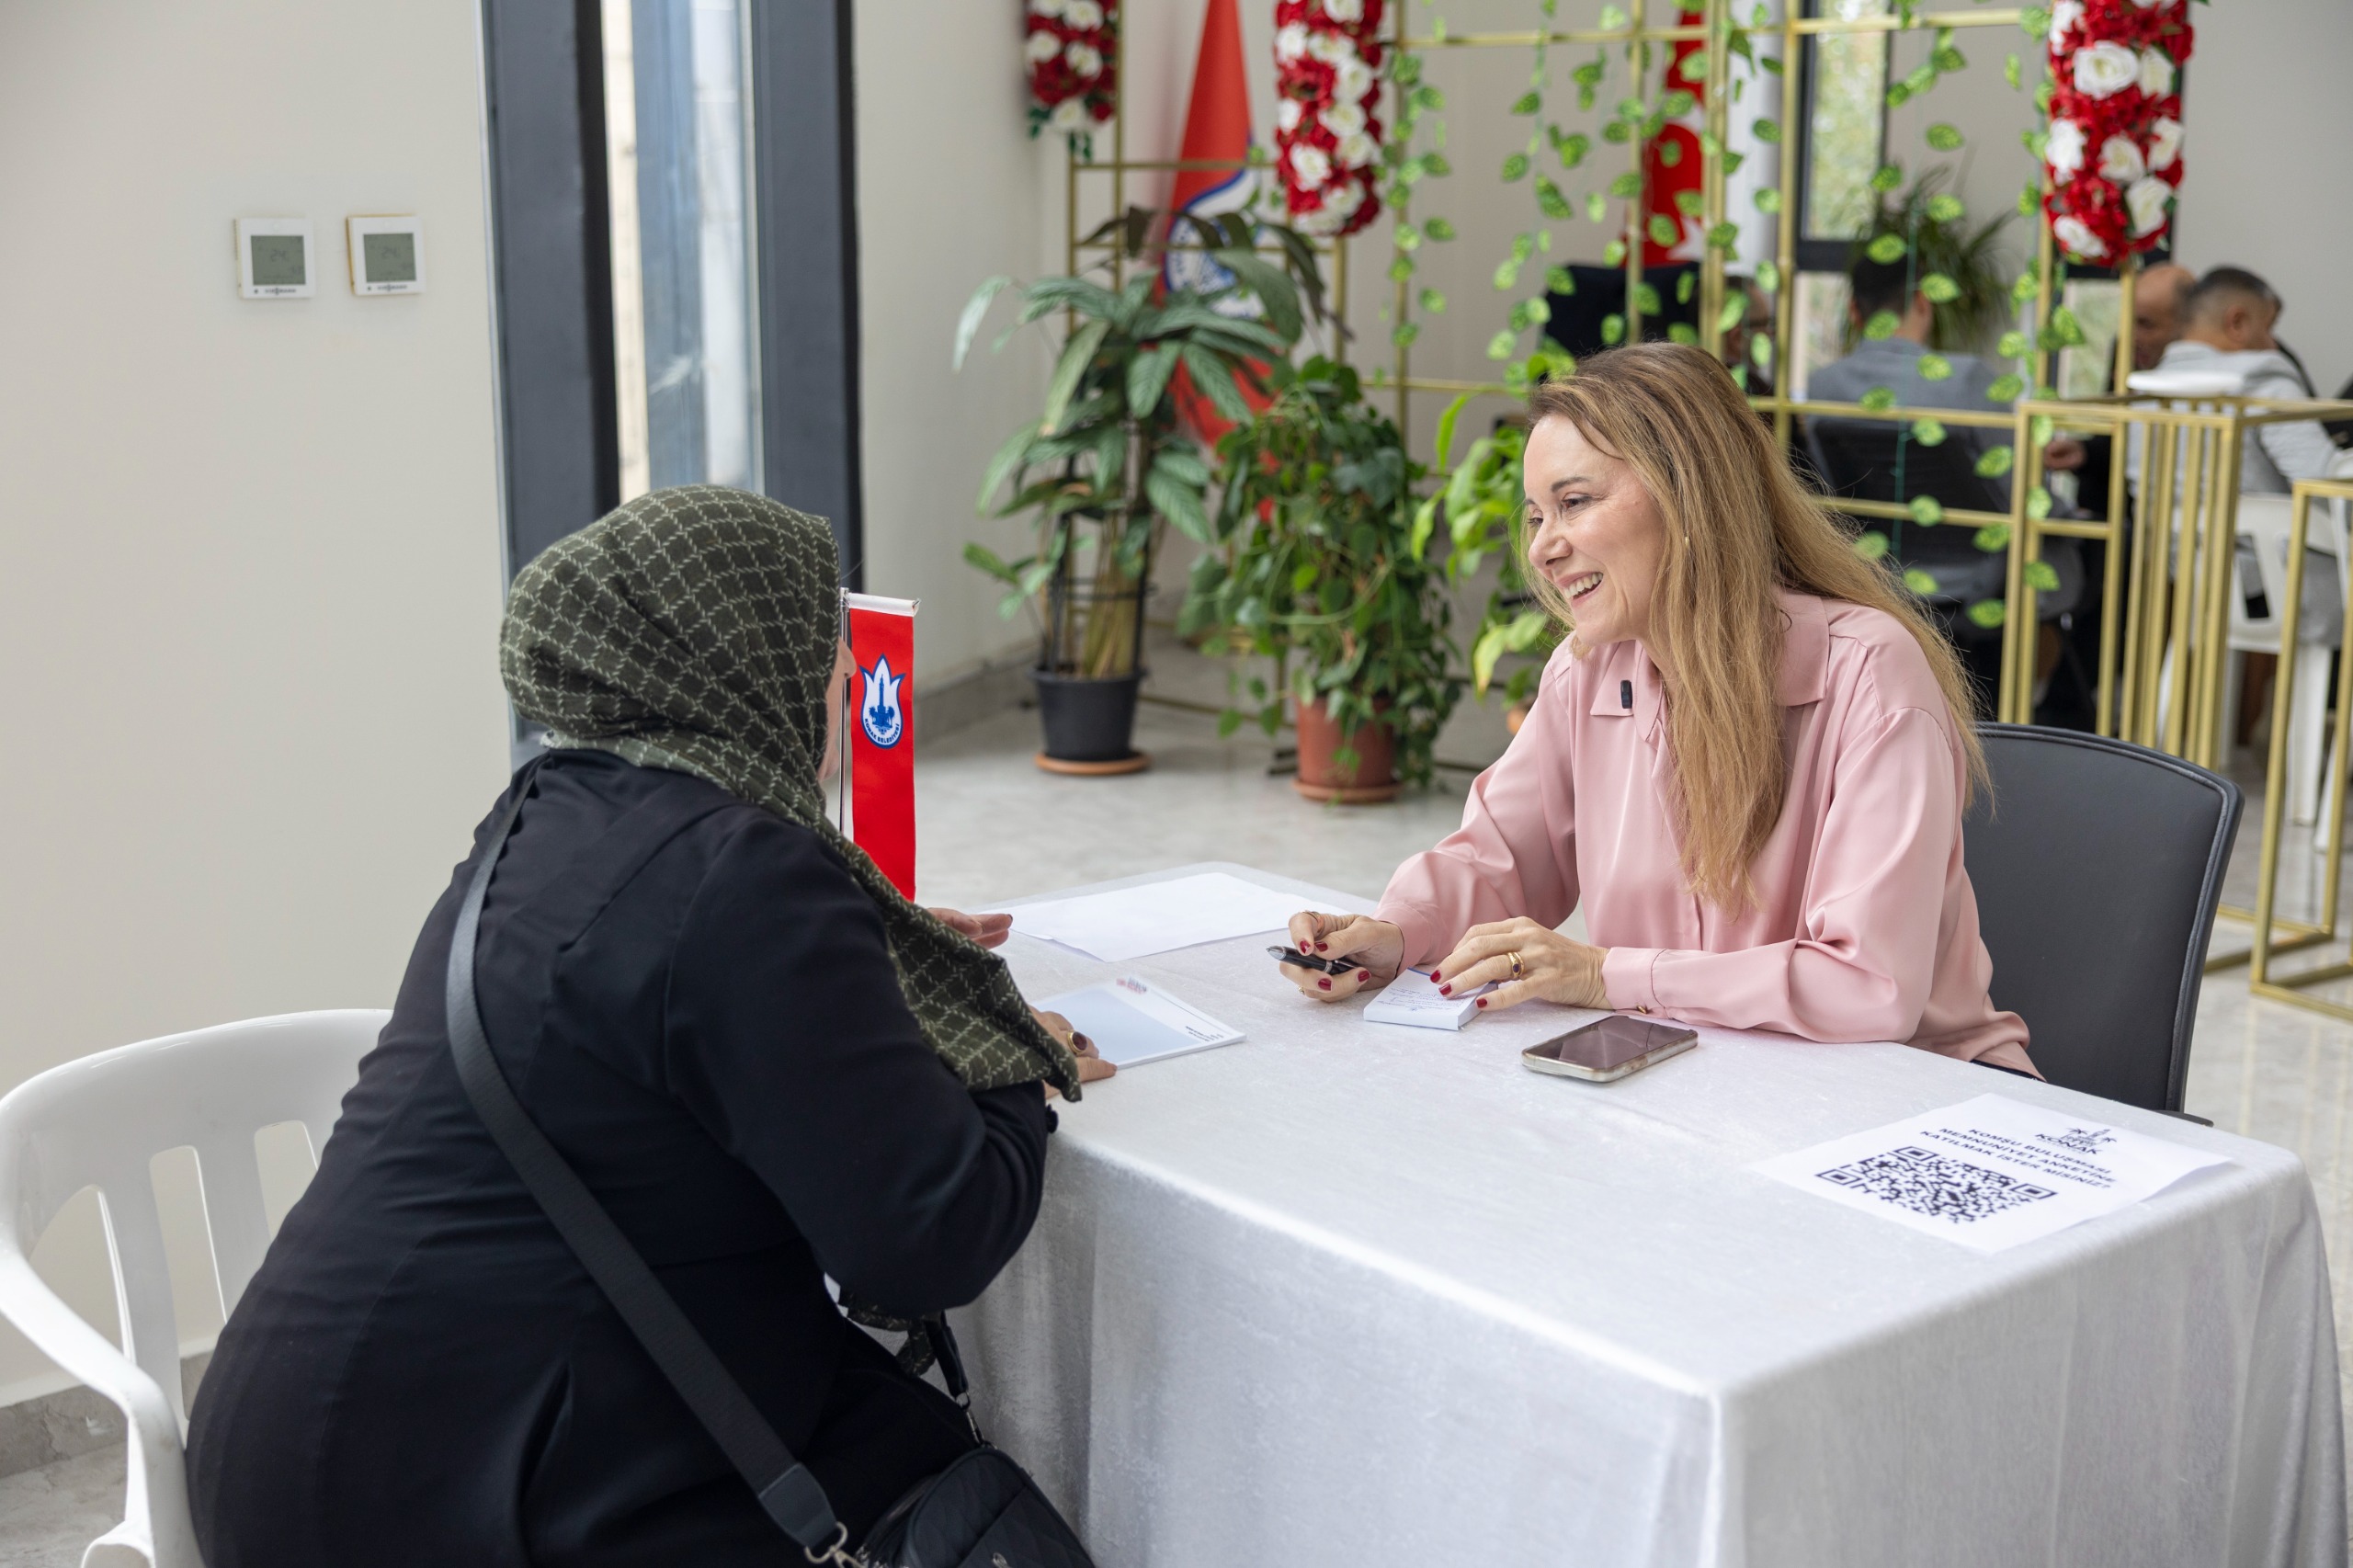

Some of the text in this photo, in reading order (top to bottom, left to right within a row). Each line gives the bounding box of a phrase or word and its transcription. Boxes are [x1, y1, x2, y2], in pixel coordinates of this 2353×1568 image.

[1920, 1131, 1995, 1155] KATILMAK
[1996, 1154, 2040, 1169] İSTER
[1938, 1128, 2038, 1158] MEMNUNİYET
[2038, 1159, 2116, 1182] ANKETİNE
[1968, 1129, 2022, 1146] KOMŞU
[2024, 1145, 2112, 1174] BULUŞMASI
[2035, 1133, 2102, 1154] KONAK
